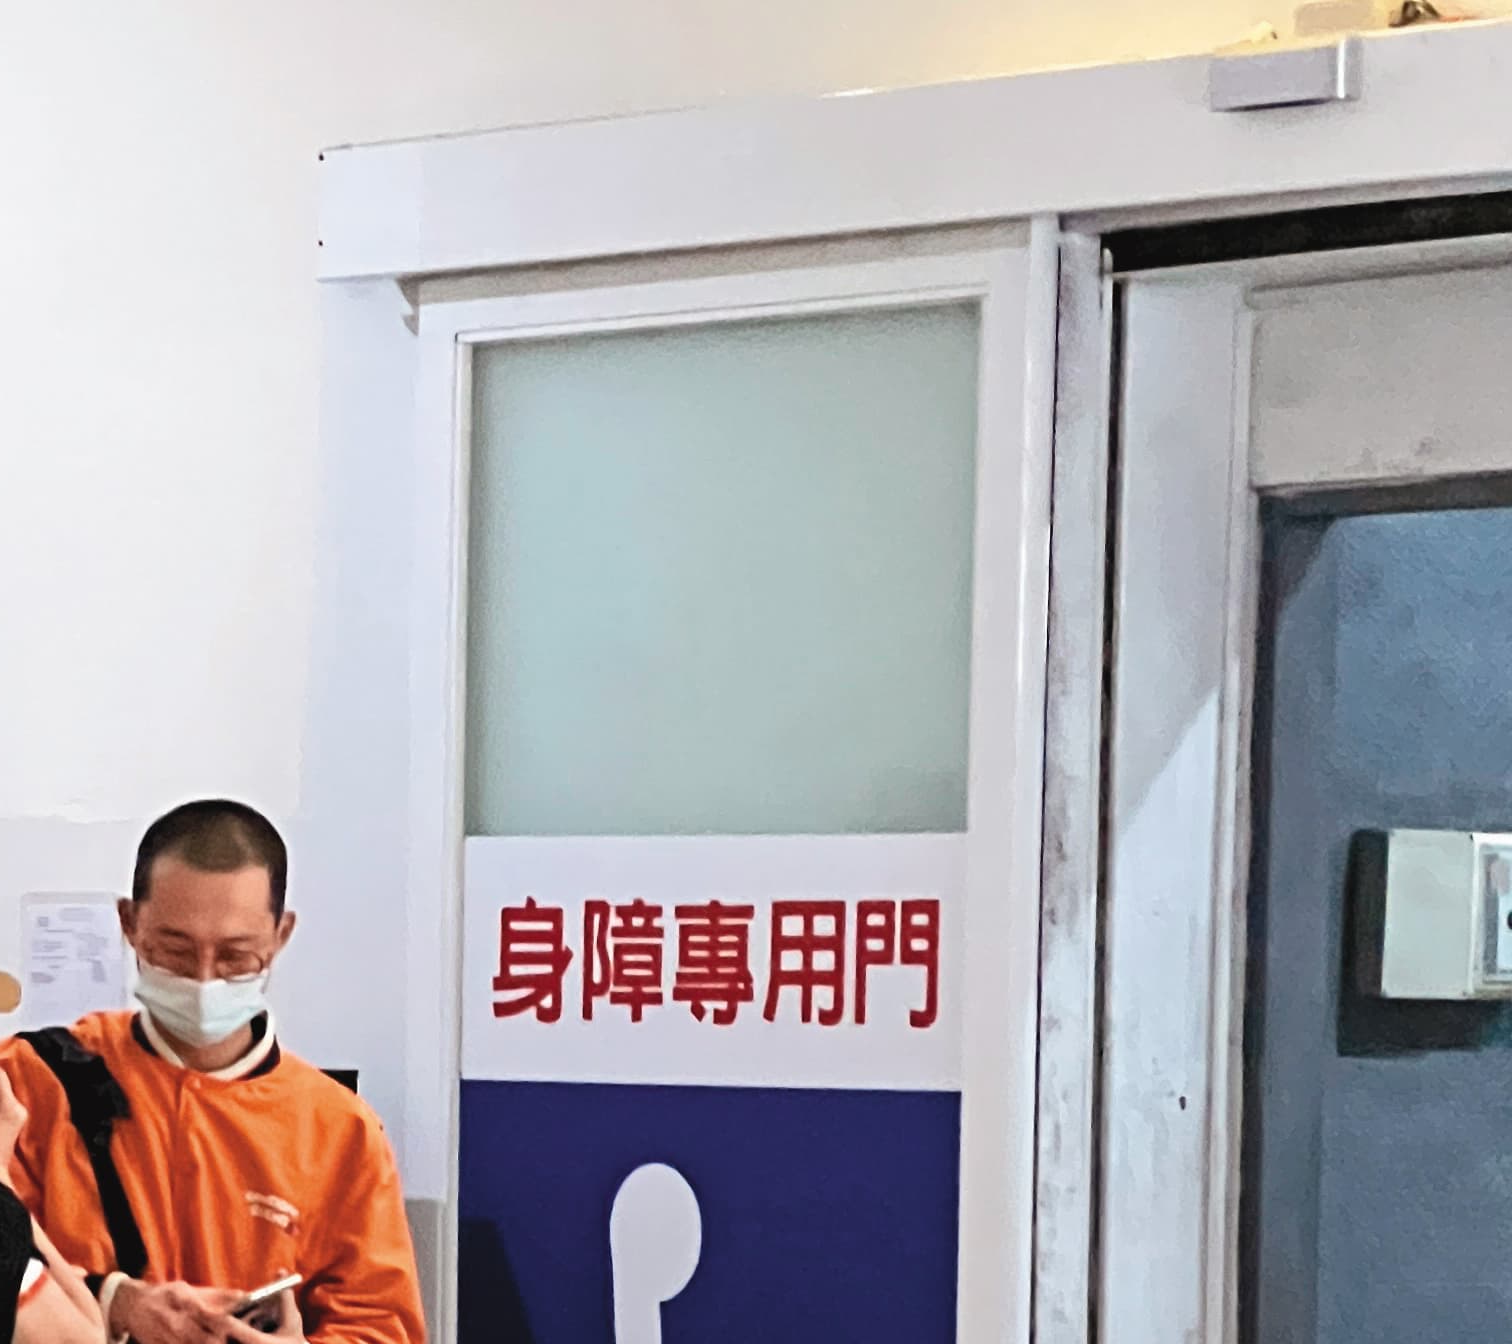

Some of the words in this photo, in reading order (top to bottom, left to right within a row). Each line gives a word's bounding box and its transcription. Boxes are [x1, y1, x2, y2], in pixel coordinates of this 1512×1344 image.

[492, 896, 941, 1028] 身障專用門
